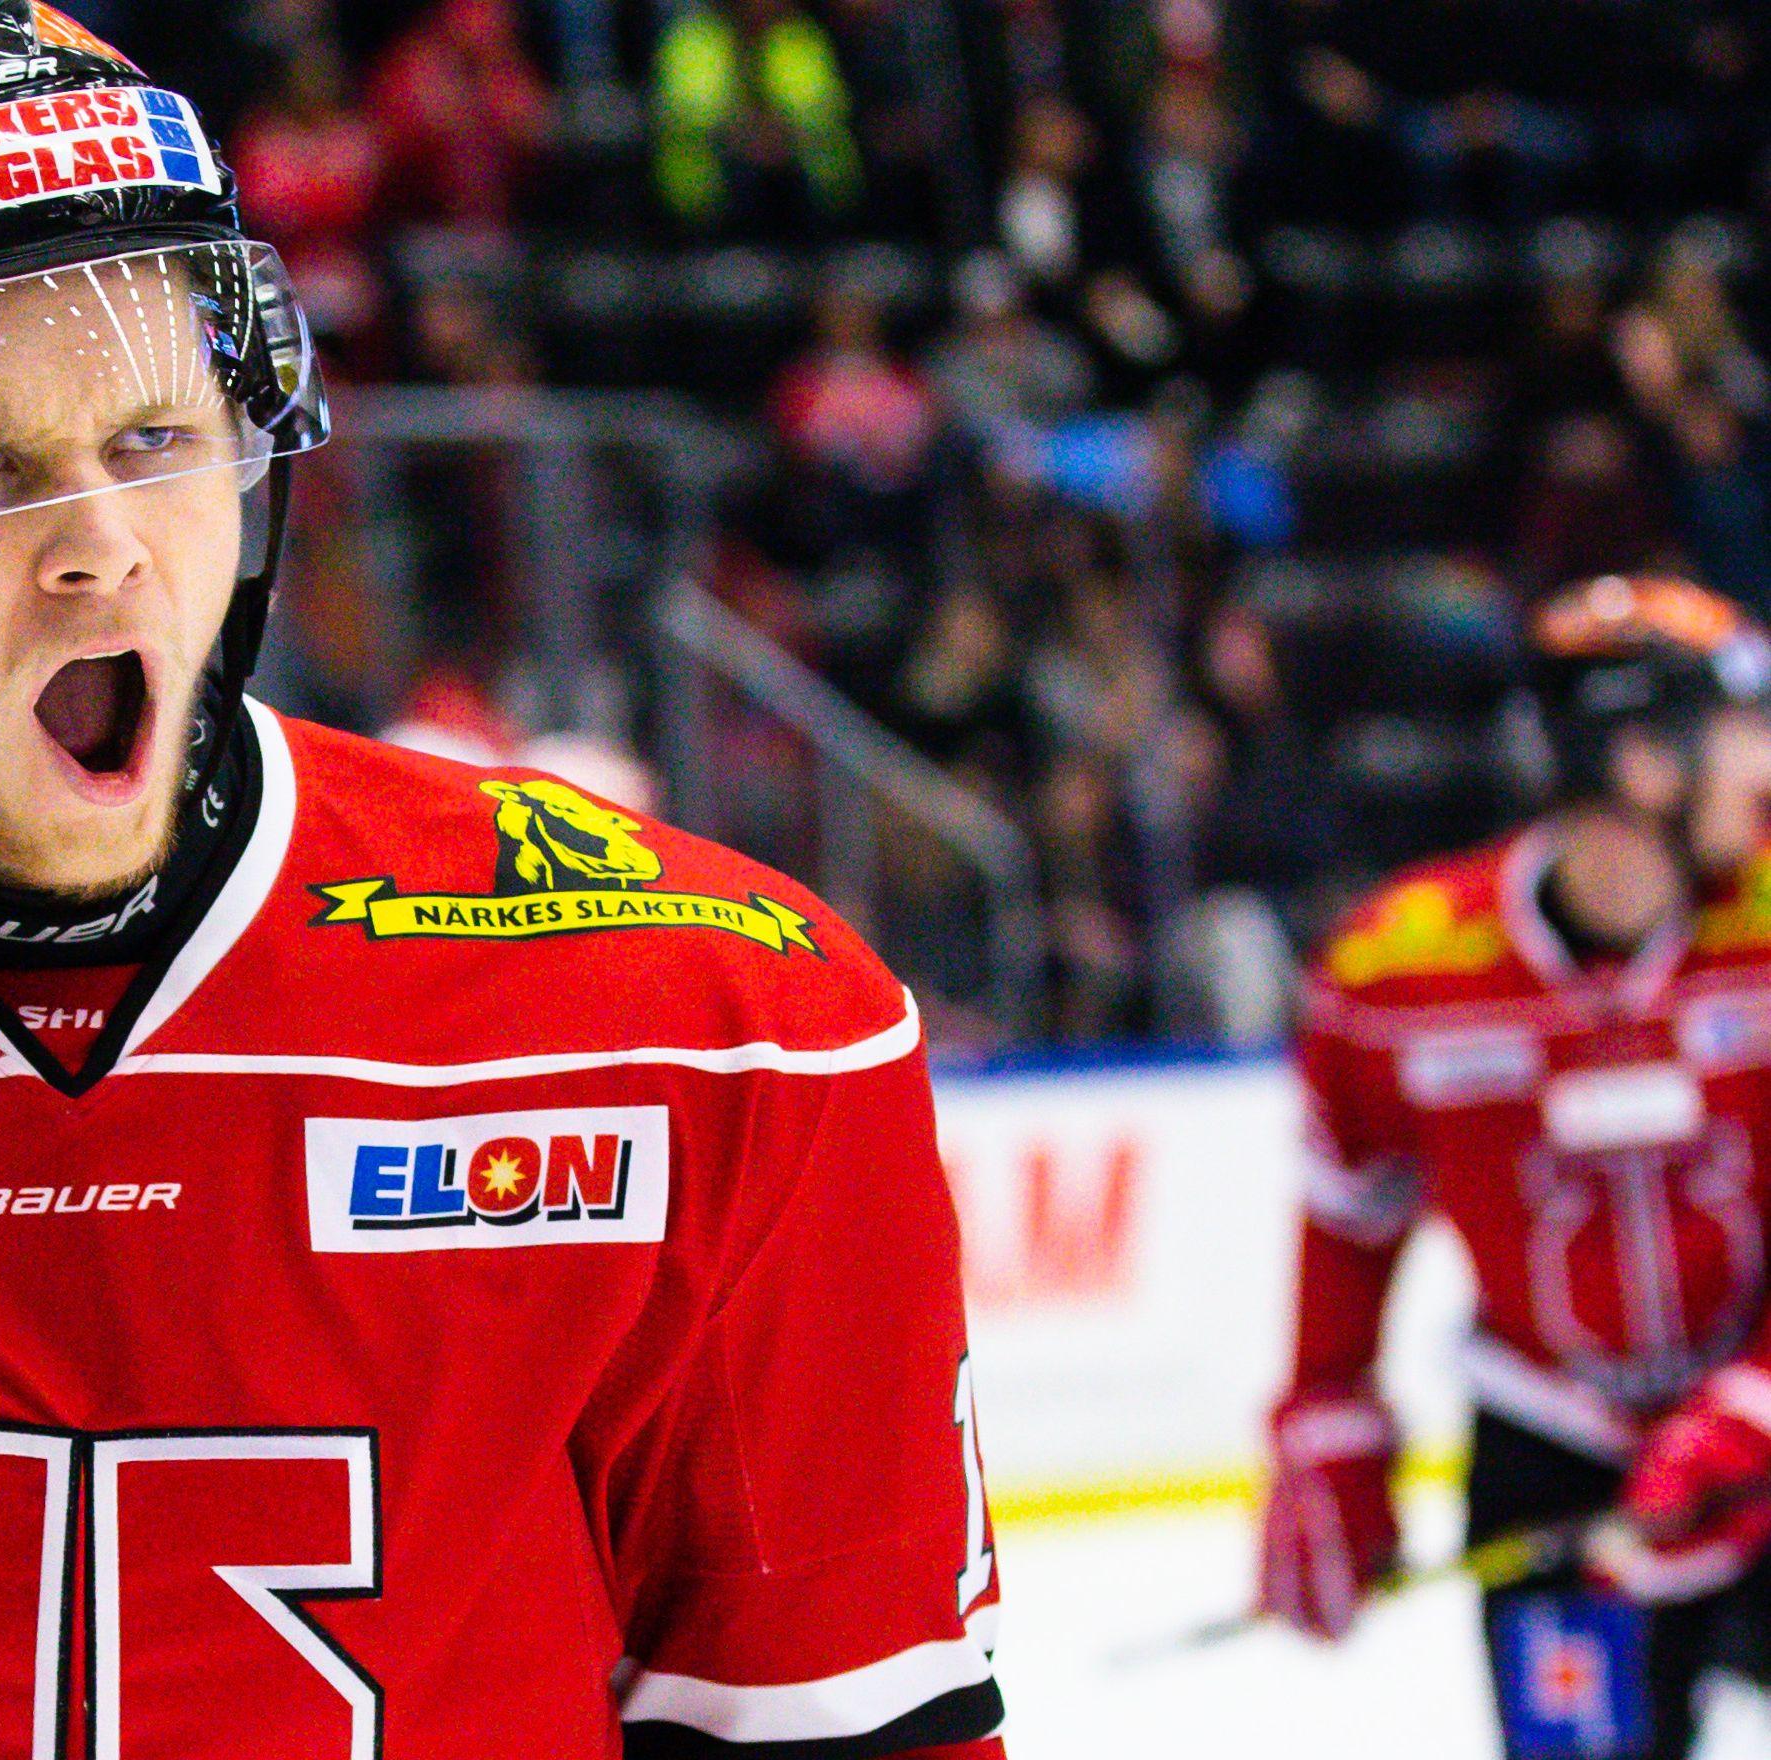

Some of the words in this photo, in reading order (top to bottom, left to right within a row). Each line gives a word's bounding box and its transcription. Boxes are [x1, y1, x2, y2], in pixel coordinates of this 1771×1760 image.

[413, 900, 564, 928] NÄRKES
[576, 899, 745, 928] SLAKTERI
[349, 1134, 628, 1225] ELON
